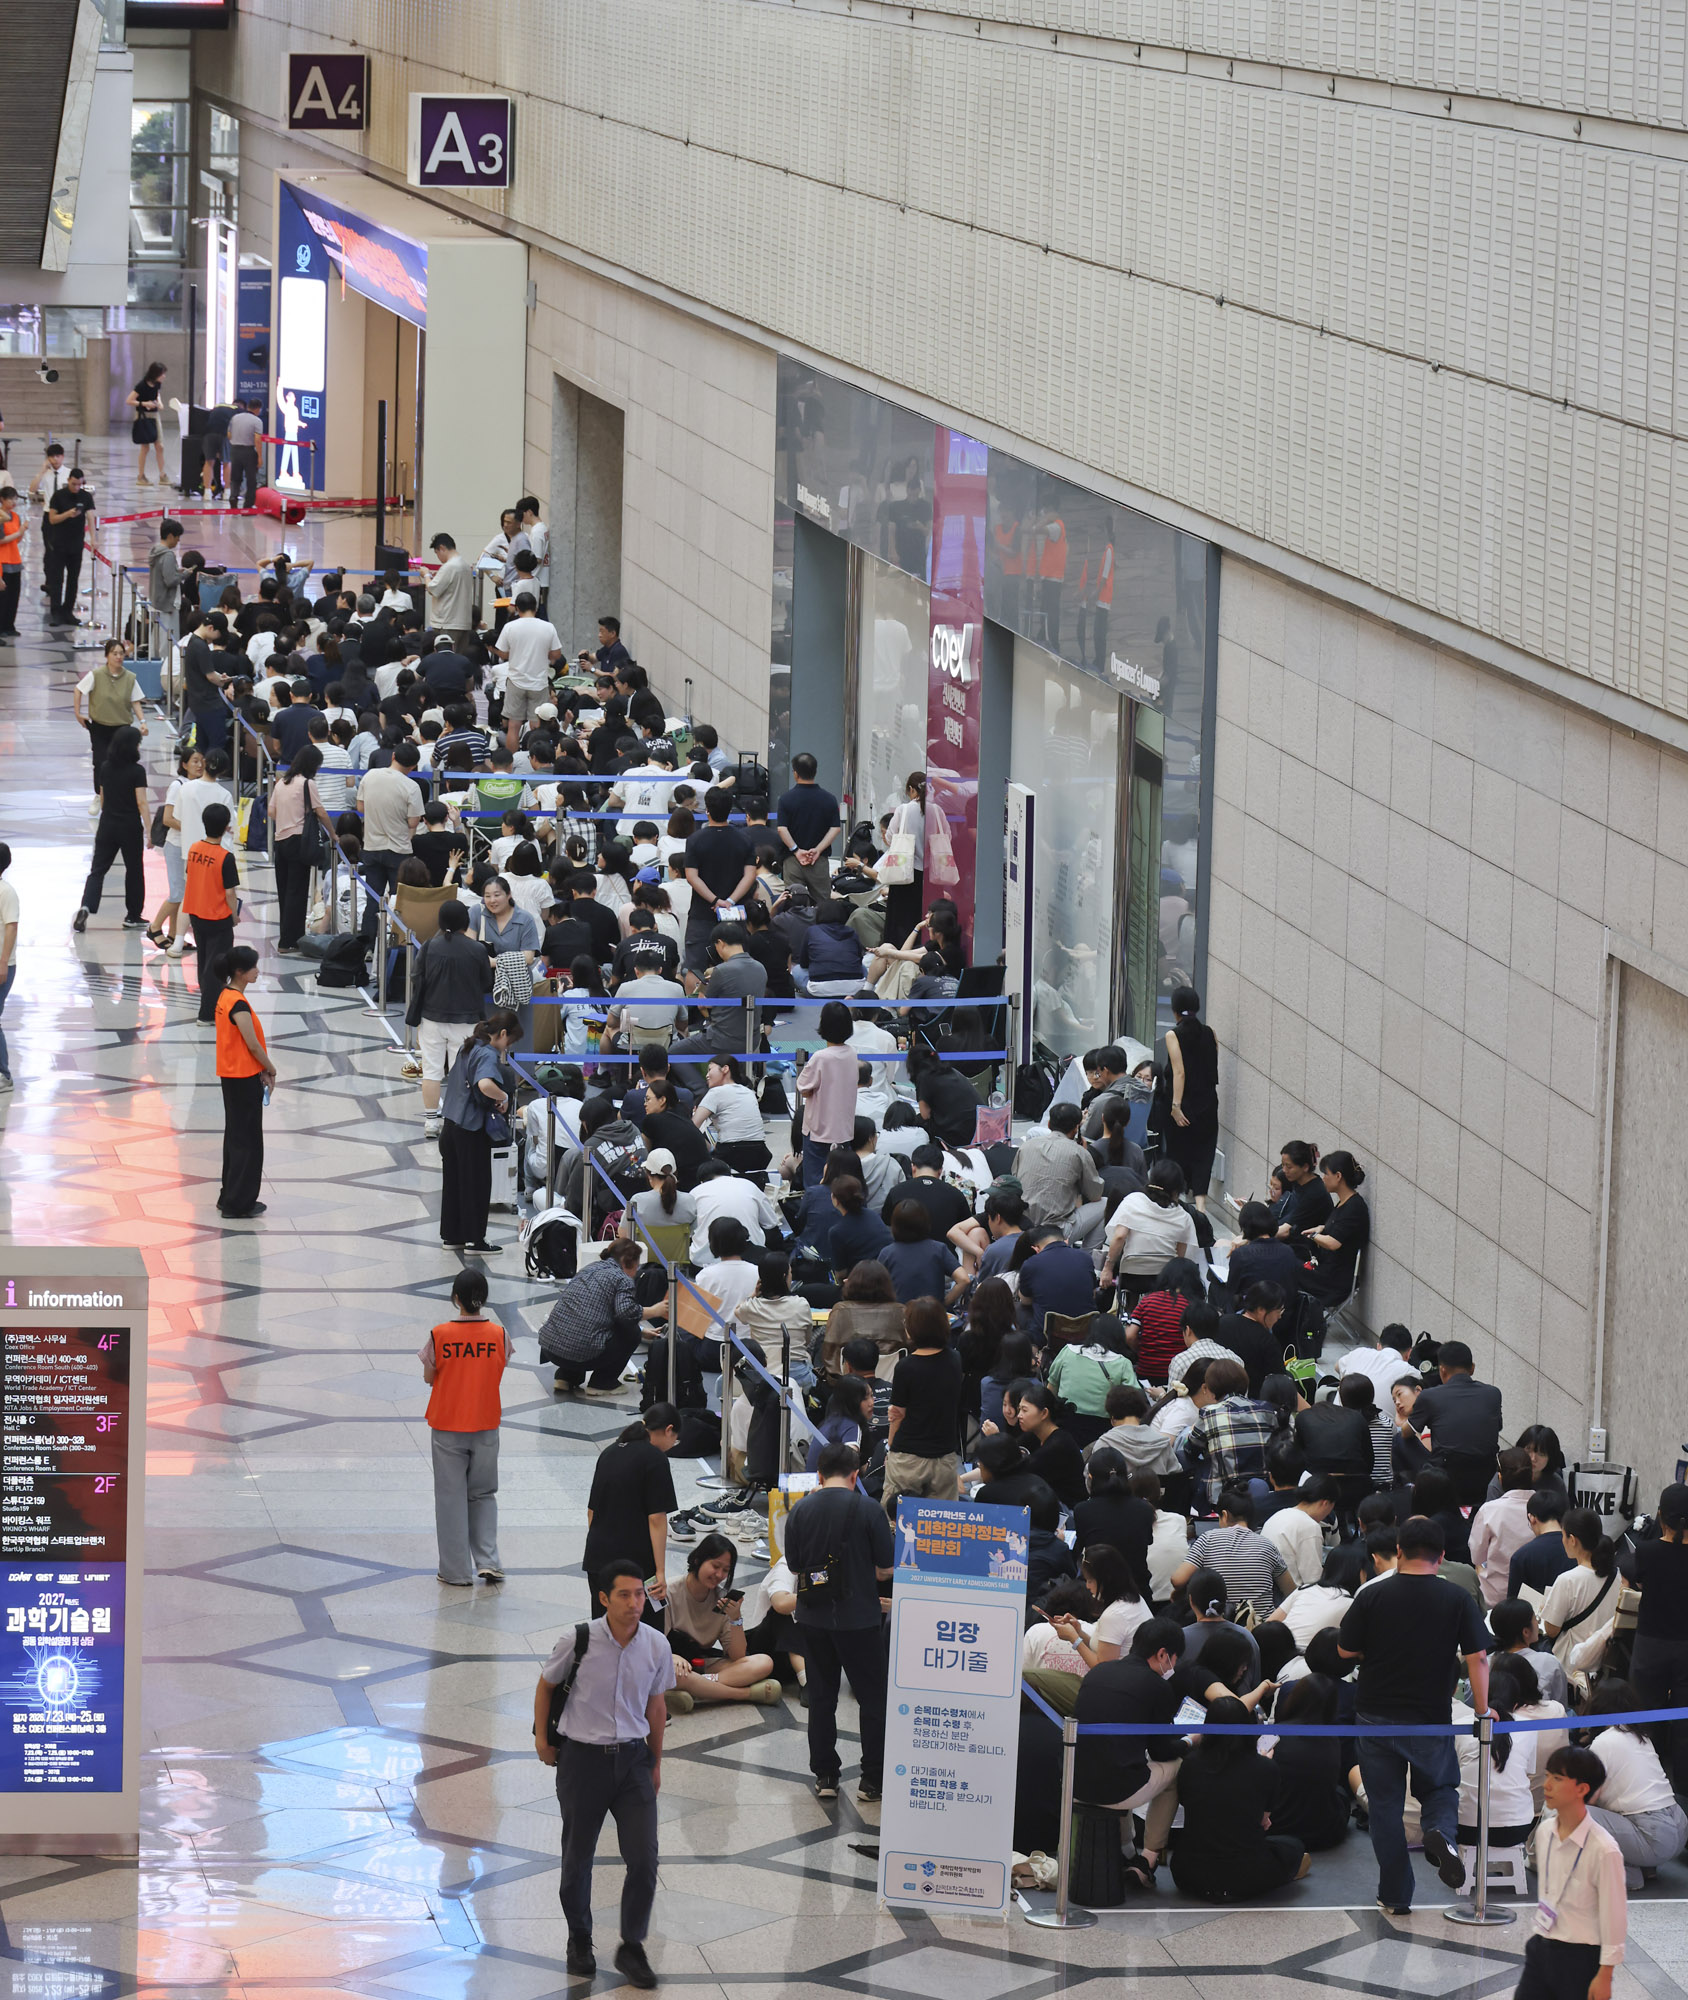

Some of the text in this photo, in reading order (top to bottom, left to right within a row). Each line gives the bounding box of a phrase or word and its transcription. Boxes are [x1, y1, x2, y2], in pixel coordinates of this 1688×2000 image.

[292, 66, 361, 120] A4
[424, 111, 504, 175] A3
[932, 623, 973, 683] coex
[646, 738, 673, 749] KOREA
[28, 1290, 123, 1308] information
[5, 1334, 67, 1344] (주)코엑스 사무실
[97, 1334, 120, 1351] 4F
[442, 1342, 497, 1359] STAFF
[5, 1354, 57, 1364] 컨퍼런스룸(남)
[5, 1375, 52, 1385] 무역아카데미
[60, 1375, 88, 1384] ICT센터
[4, 1395, 108, 1404] 한국무역협회 일자리지원센터
[4, 1415, 35, 1425] 전시홀 C
[96, 1415, 119, 1432] 3F
[4, 1435, 55, 1445] 컨퍼런스룸(남)
[3, 1455, 49, 1465] 컨퍼런스룸 E
[3, 1476, 34, 1485] 더플라츠
[94, 1476, 117, 1493] 2F
[2, 1496, 45, 1505] 스튜디오159
[2, 1516, 51, 1525] 바이킹스 워프
[917, 1509, 984, 1522] 2027학년도 수시
[917, 1520, 1007, 1541] 대학입학정보
[2, 1536, 105, 1545] 한국무역협회 스타트업브랜치
[916, 1539, 961, 1556] 박람회
[35, 1573, 54, 1581] GIST
[924, 1576, 952, 1584] UNIVERSITY
[967, 1580, 998, 1588] ADMISSIONS
[6, 1607, 111, 1633] 과학기술원
[936, 1620, 980, 1643] 입장
[80, 1636, 94, 1646] 상담
[923, 1647, 989, 1673] 대기줄
[914, 1705, 985, 1720] 손목띠수령처에서
[13, 1724, 27, 1733] 장소
[28, 1724, 45, 1733] COEX
[913, 1716, 974, 1731] 손목띠 수령 후,
[913, 1728, 969, 1741] 착용하신 분만
[912, 1738, 1006, 1756] 입장대기하는 줄입니다.
[911, 1765, 955, 1778] 대기줄에서
[910, 1777, 969, 1790] 손목띠 착용 후
[910, 1788, 992, 1804] 확인도장을 받으시기
[909, 1800, 947, 1811] 바랍니다.
